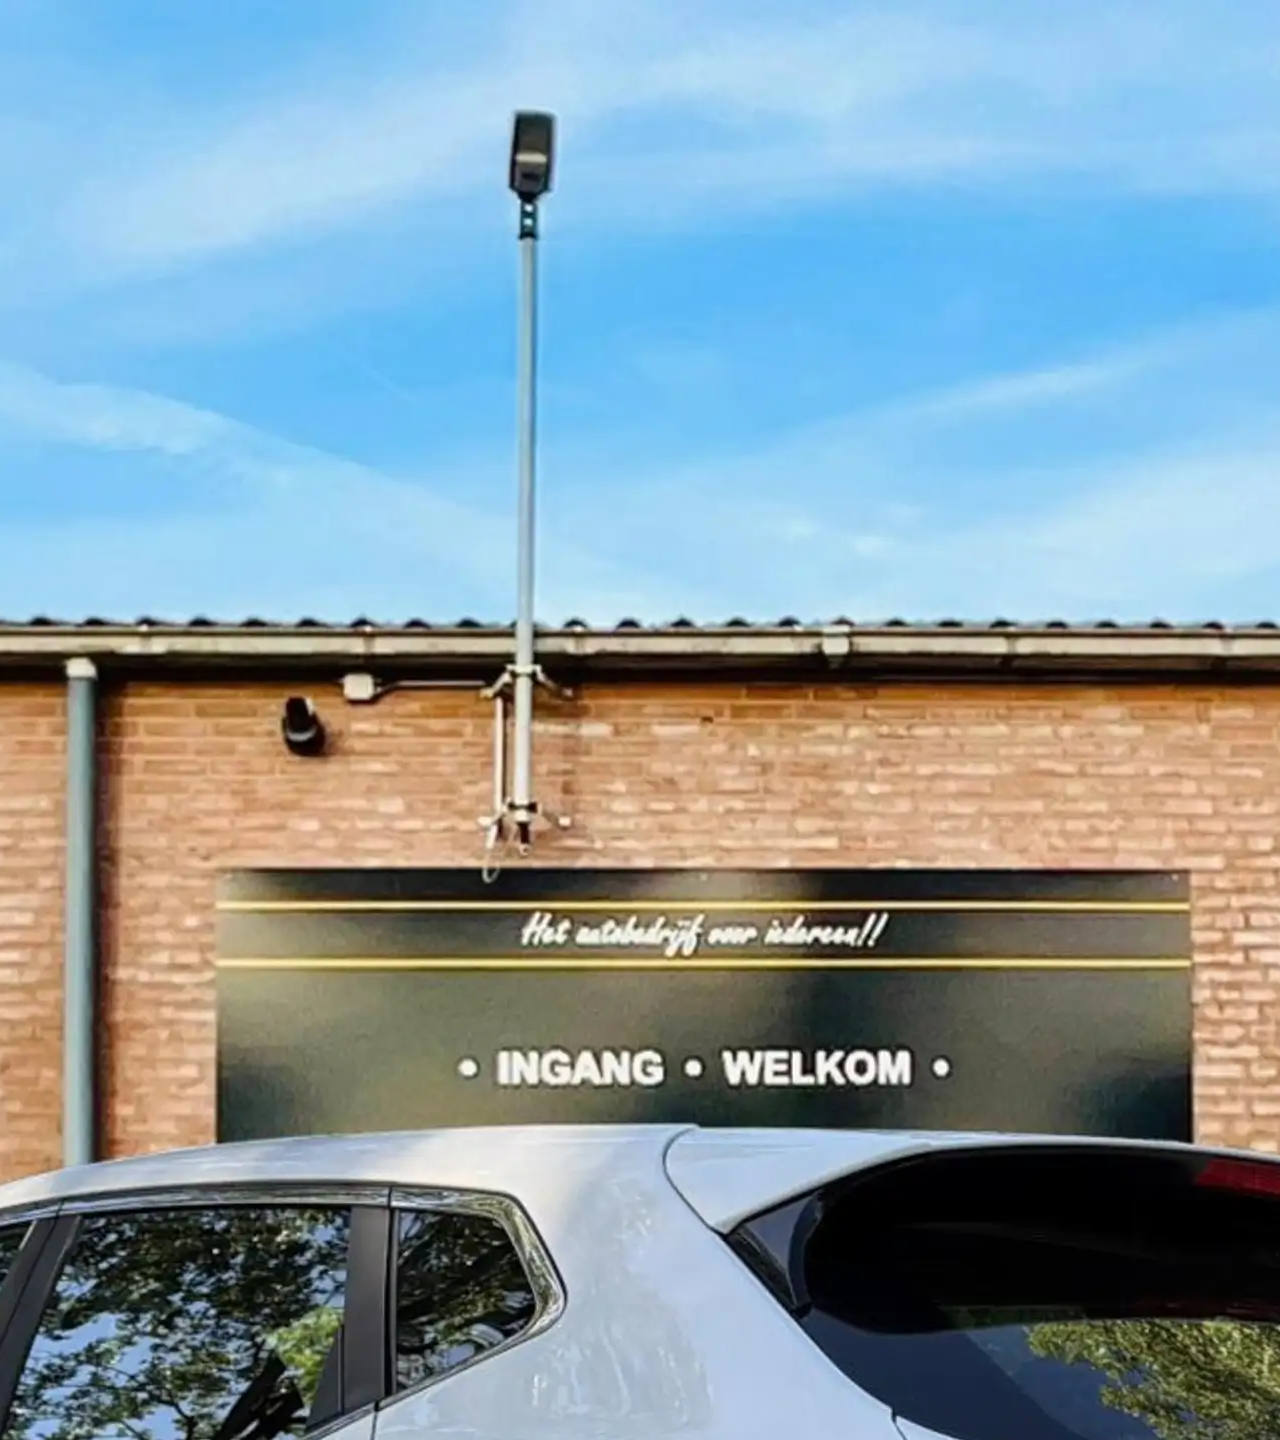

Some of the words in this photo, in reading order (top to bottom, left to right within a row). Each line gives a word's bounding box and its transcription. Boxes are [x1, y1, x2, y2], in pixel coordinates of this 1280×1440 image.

[521, 912, 572, 947] Het
[497, 1049, 666, 1087] INGANG
[722, 1049, 913, 1087] WELKOM
